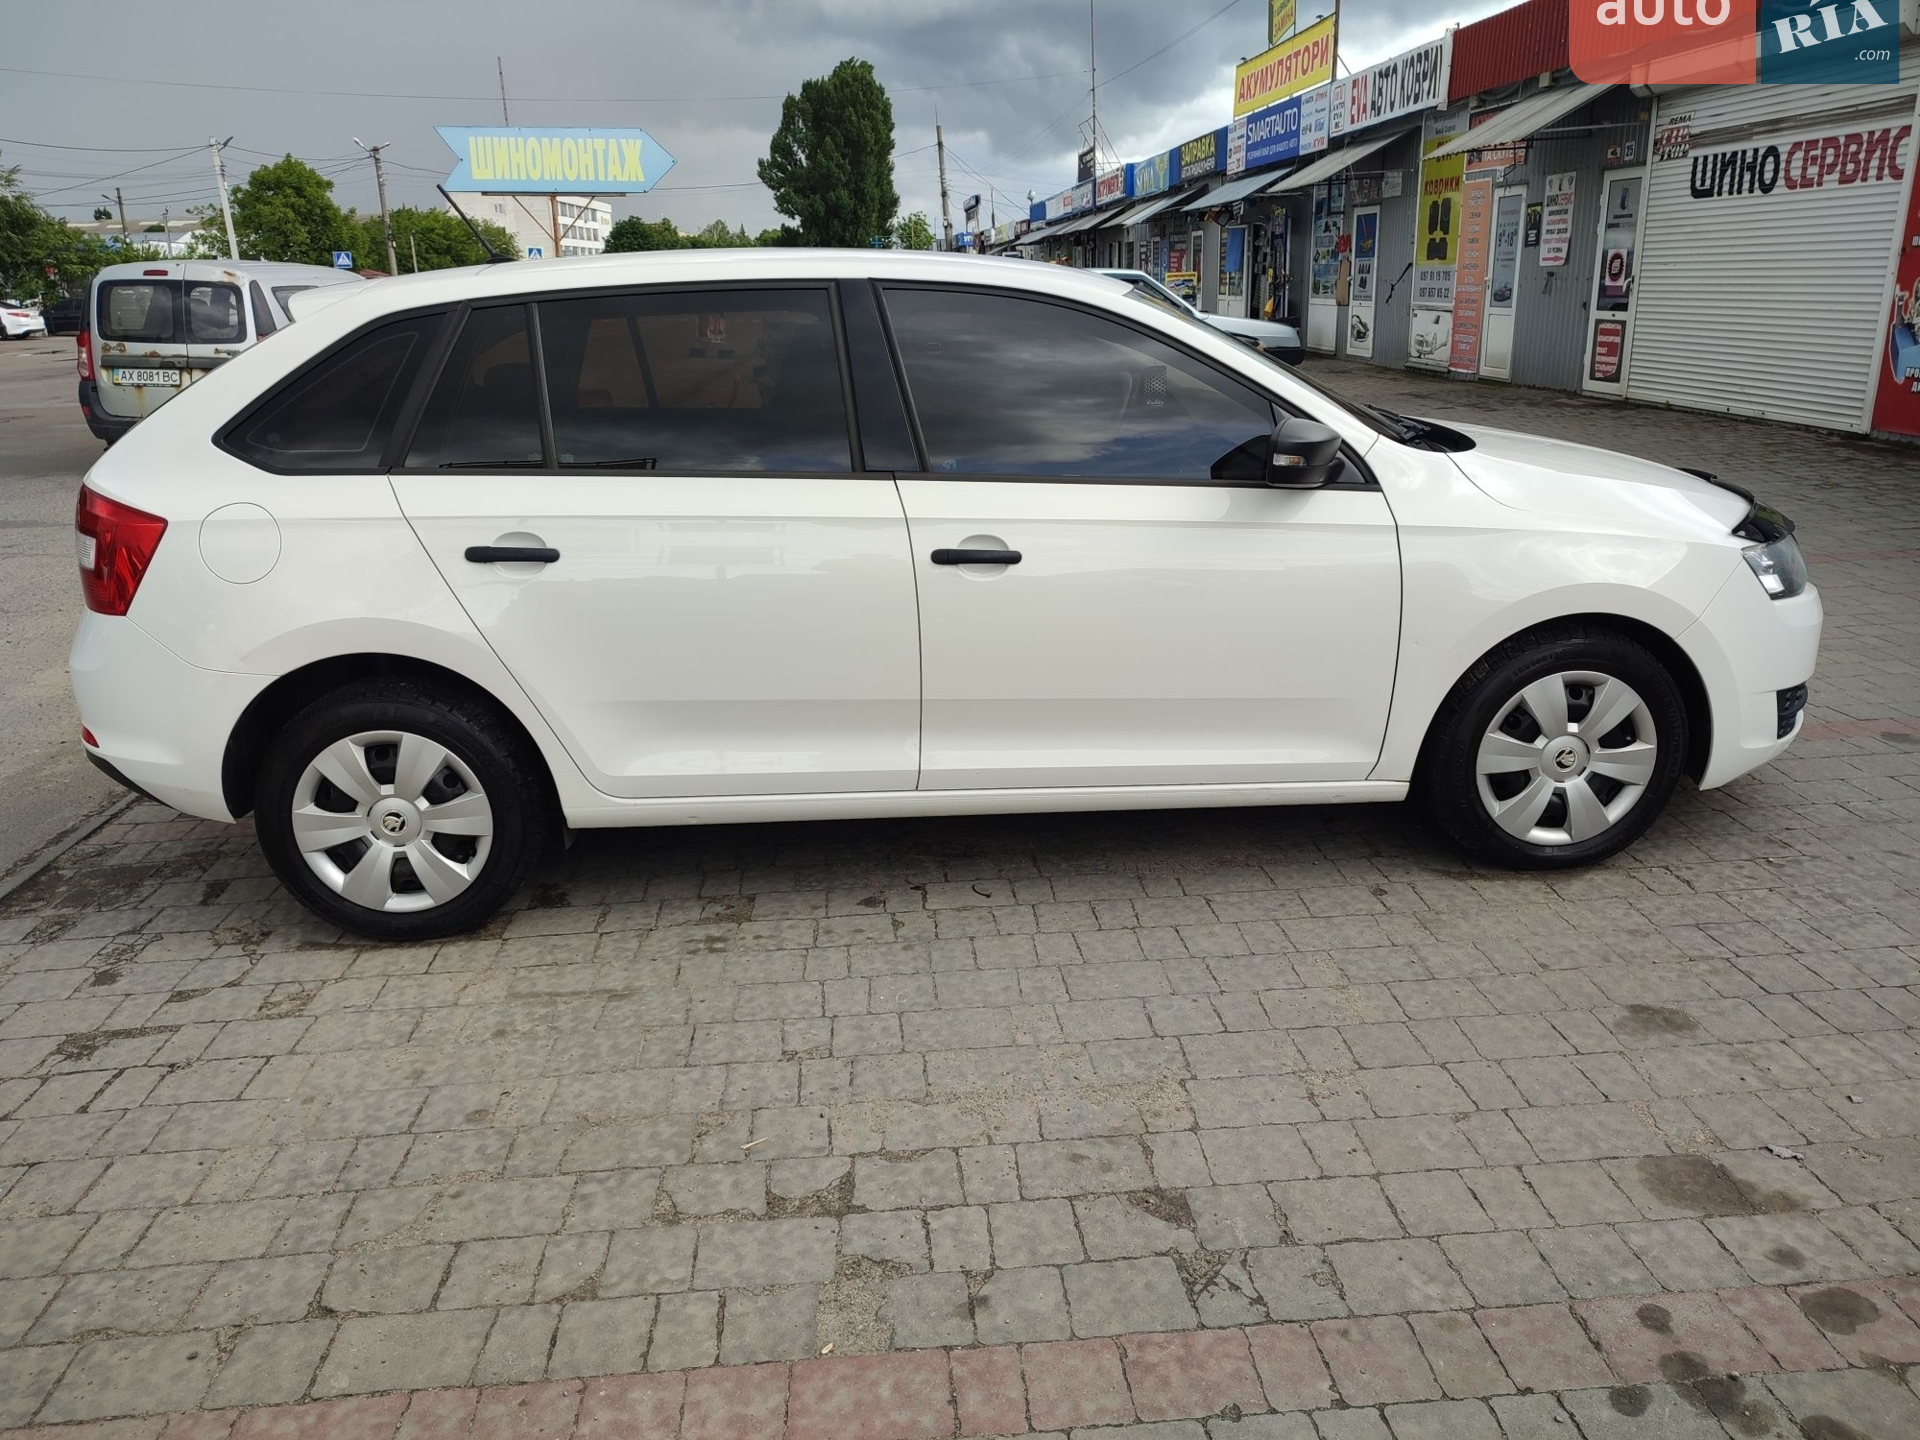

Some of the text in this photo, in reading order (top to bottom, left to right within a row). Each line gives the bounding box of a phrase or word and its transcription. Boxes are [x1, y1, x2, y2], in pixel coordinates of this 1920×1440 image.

[1238, 34, 1329, 103] АКУМУЛЯТОРИ
[1370, 62, 1398, 119] АВТО
[1247, 107, 1298, 145] SMARTAUTO
[469, 136, 645, 182] ШИНОМОНТАЖ
[1181, 133, 1215, 167] ЗАПРАВКА
[1424, 177, 1460, 199] КОВРИКИ
[120, 371, 178, 382] AX 8081 BC
